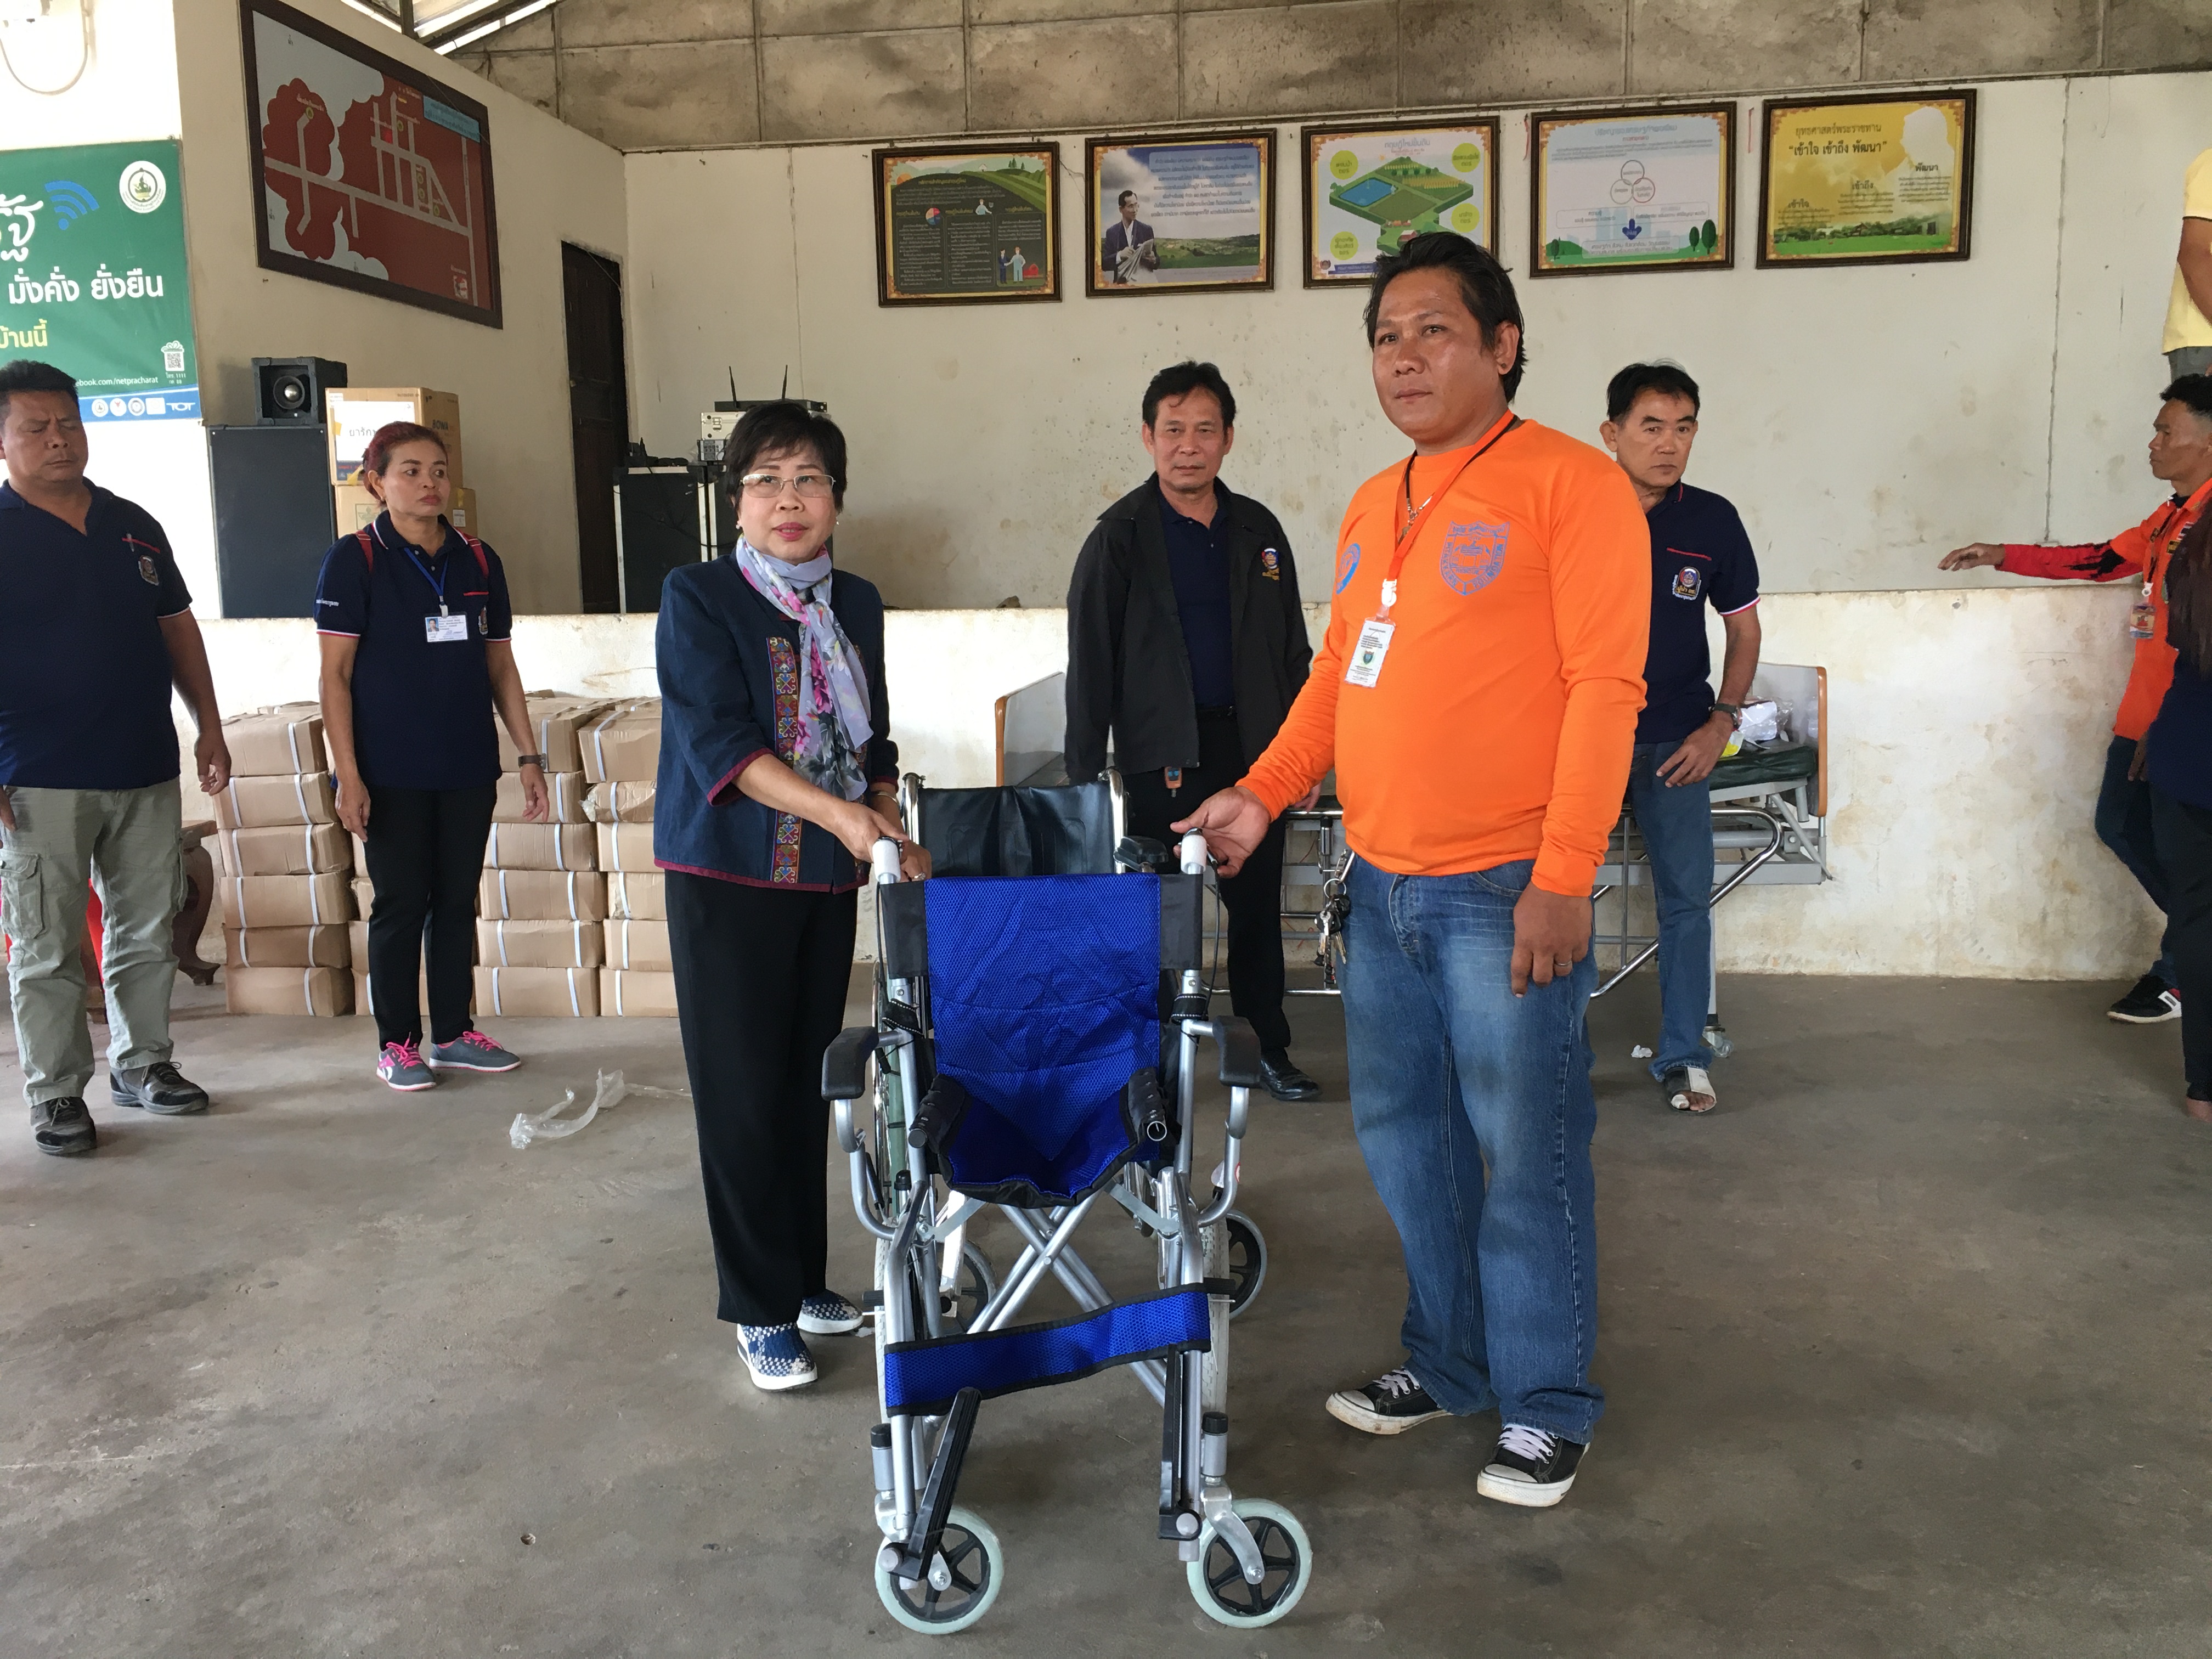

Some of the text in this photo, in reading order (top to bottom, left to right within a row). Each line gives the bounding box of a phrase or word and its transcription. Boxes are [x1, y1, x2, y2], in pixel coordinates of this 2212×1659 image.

[1822, 140, 1849, 155] เข้าถึง
[8, 263, 164, 304] มั่งคั่ง ยั่งยืน
[166, 402, 196, 411] TOT
